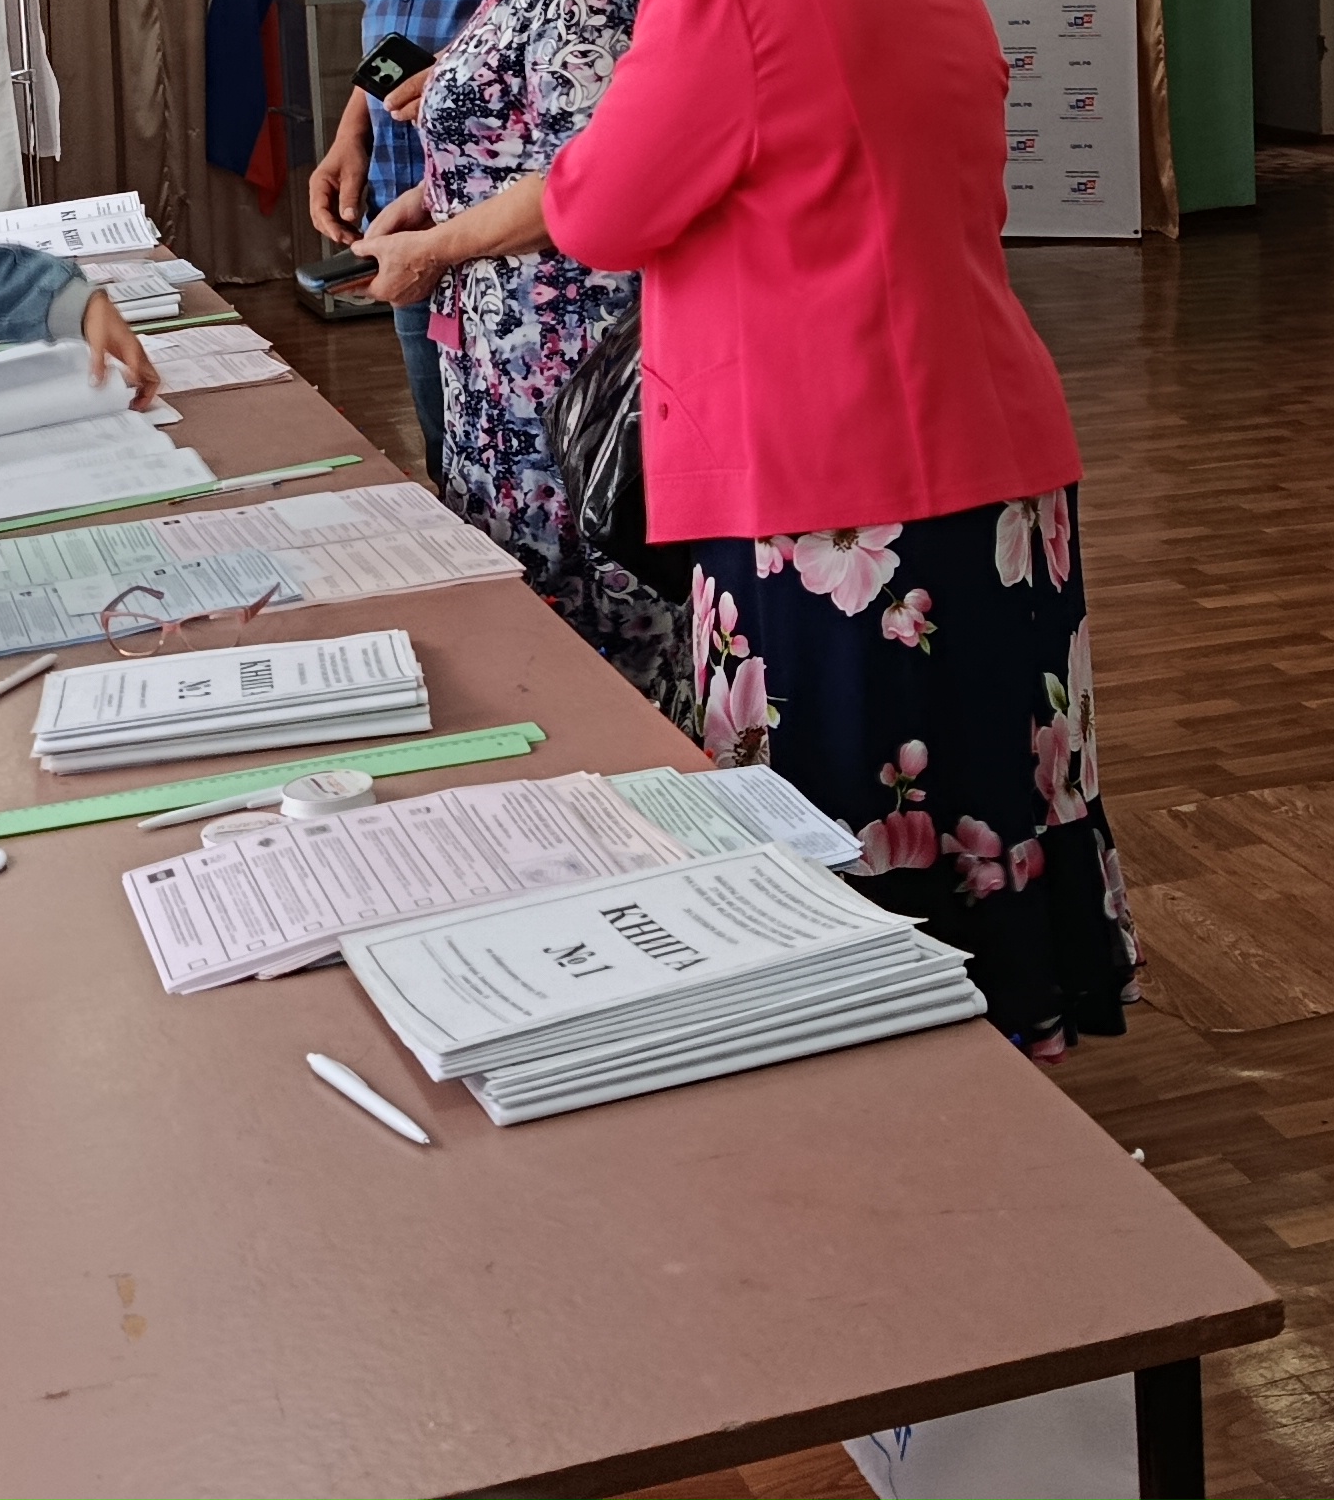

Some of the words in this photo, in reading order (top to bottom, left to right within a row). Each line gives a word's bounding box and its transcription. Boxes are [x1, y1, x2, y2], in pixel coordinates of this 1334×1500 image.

[240, 659, 274, 697] КНИГА
[598, 902, 710, 972] КНИГА
[543, 942, 596, 968] №
[572, 965, 615, 978] 1
